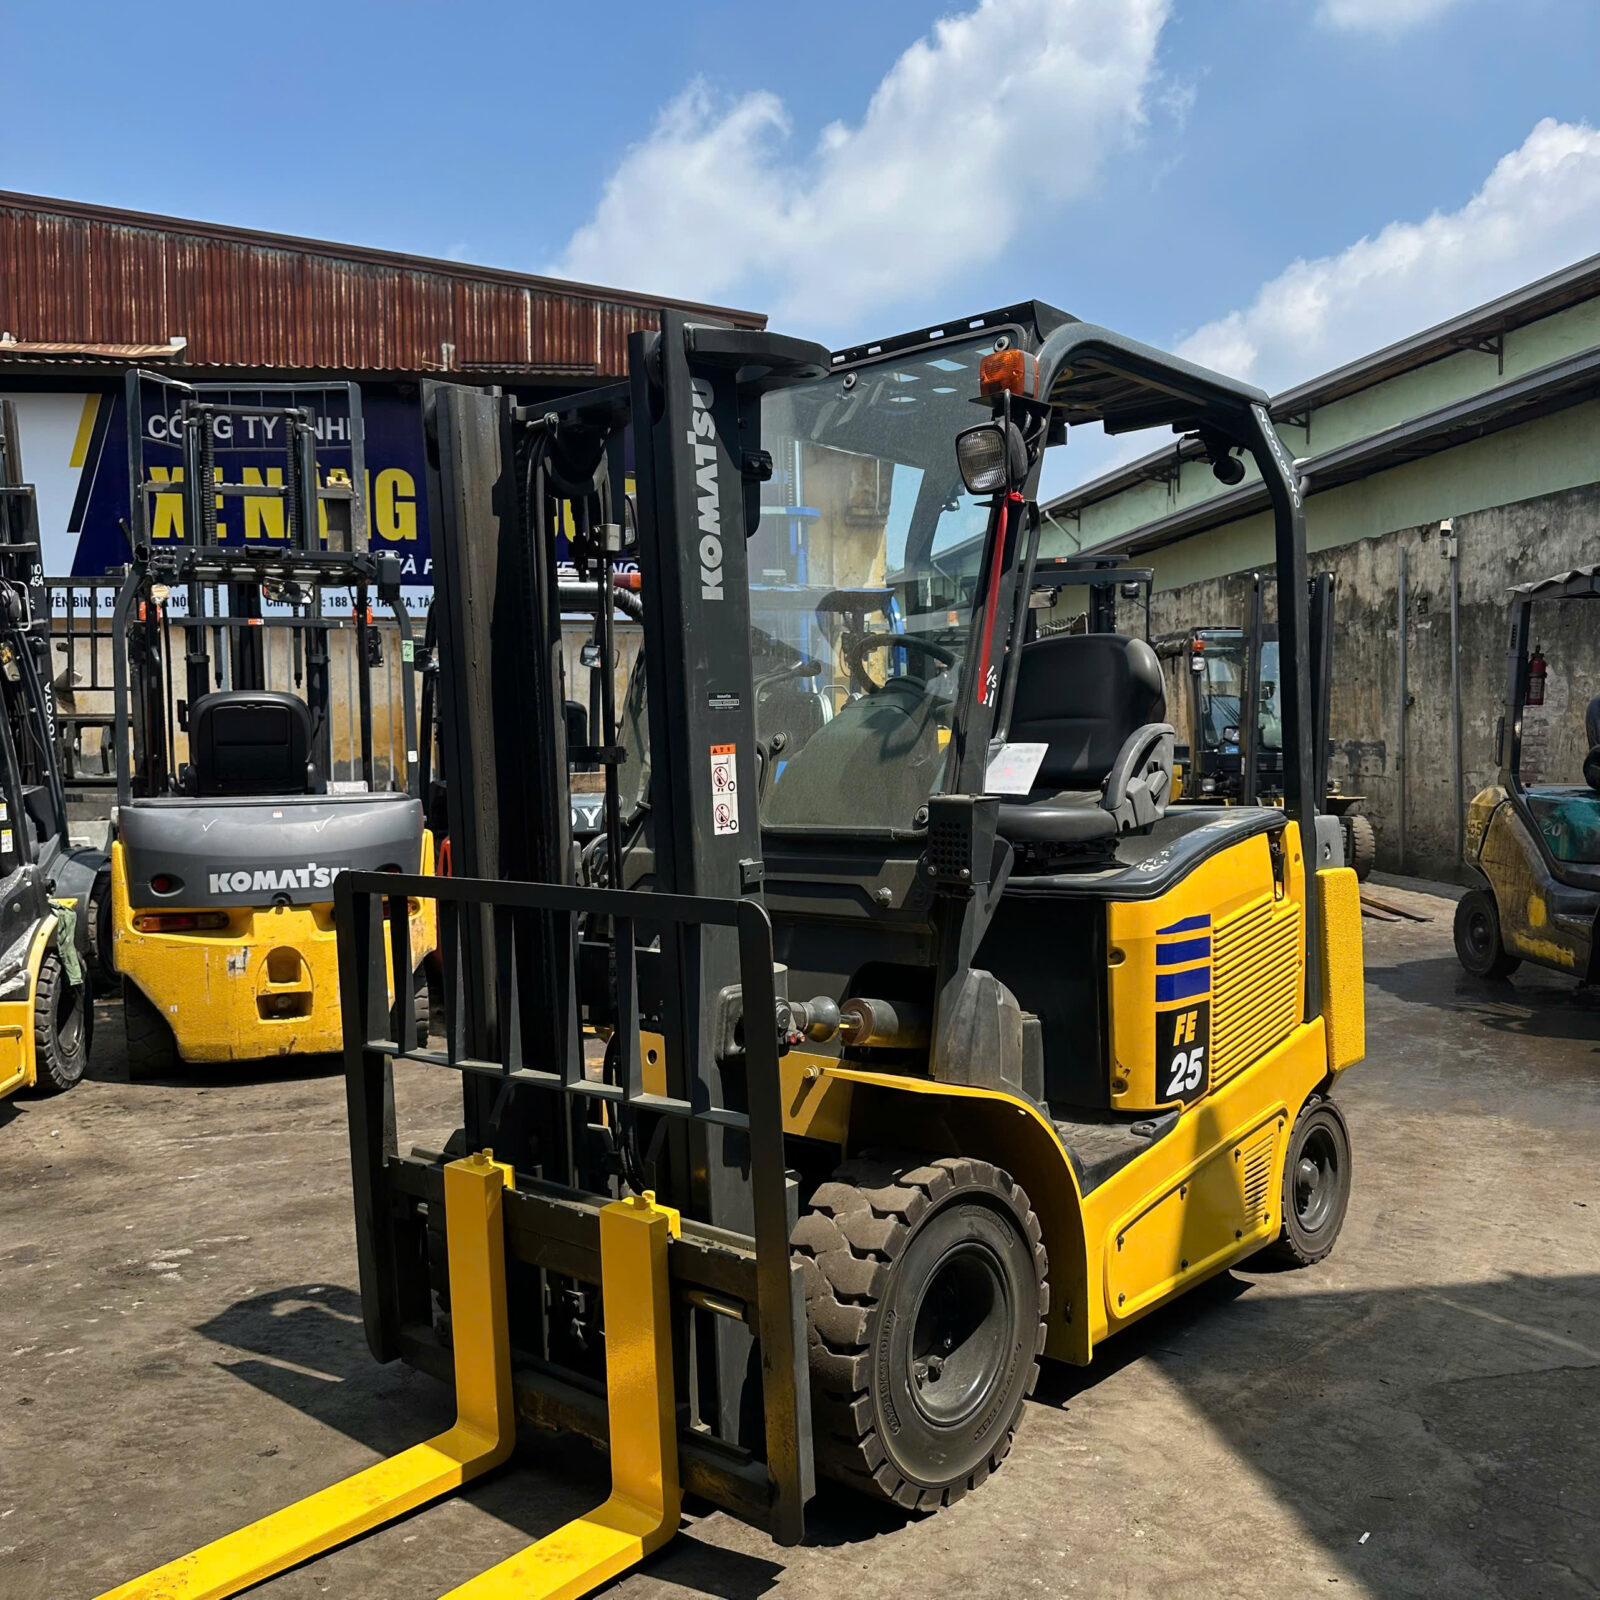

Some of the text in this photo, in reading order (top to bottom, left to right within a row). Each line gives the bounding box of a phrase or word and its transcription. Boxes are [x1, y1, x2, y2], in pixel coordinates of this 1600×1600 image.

[148, 408, 233, 439] CÔG
[242, 415, 279, 440] TY
[686, 377, 724, 600] KOMATSU
[29, 575, 44, 588] 454
[73, 593, 102, 609] BÌN,
[172, 593, 189, 610] NỘ
[329, 596, 348, 608] 188
[1172, 1009, 1199, 1047] FE
[1165, 1046, 1205, 1097] 25
